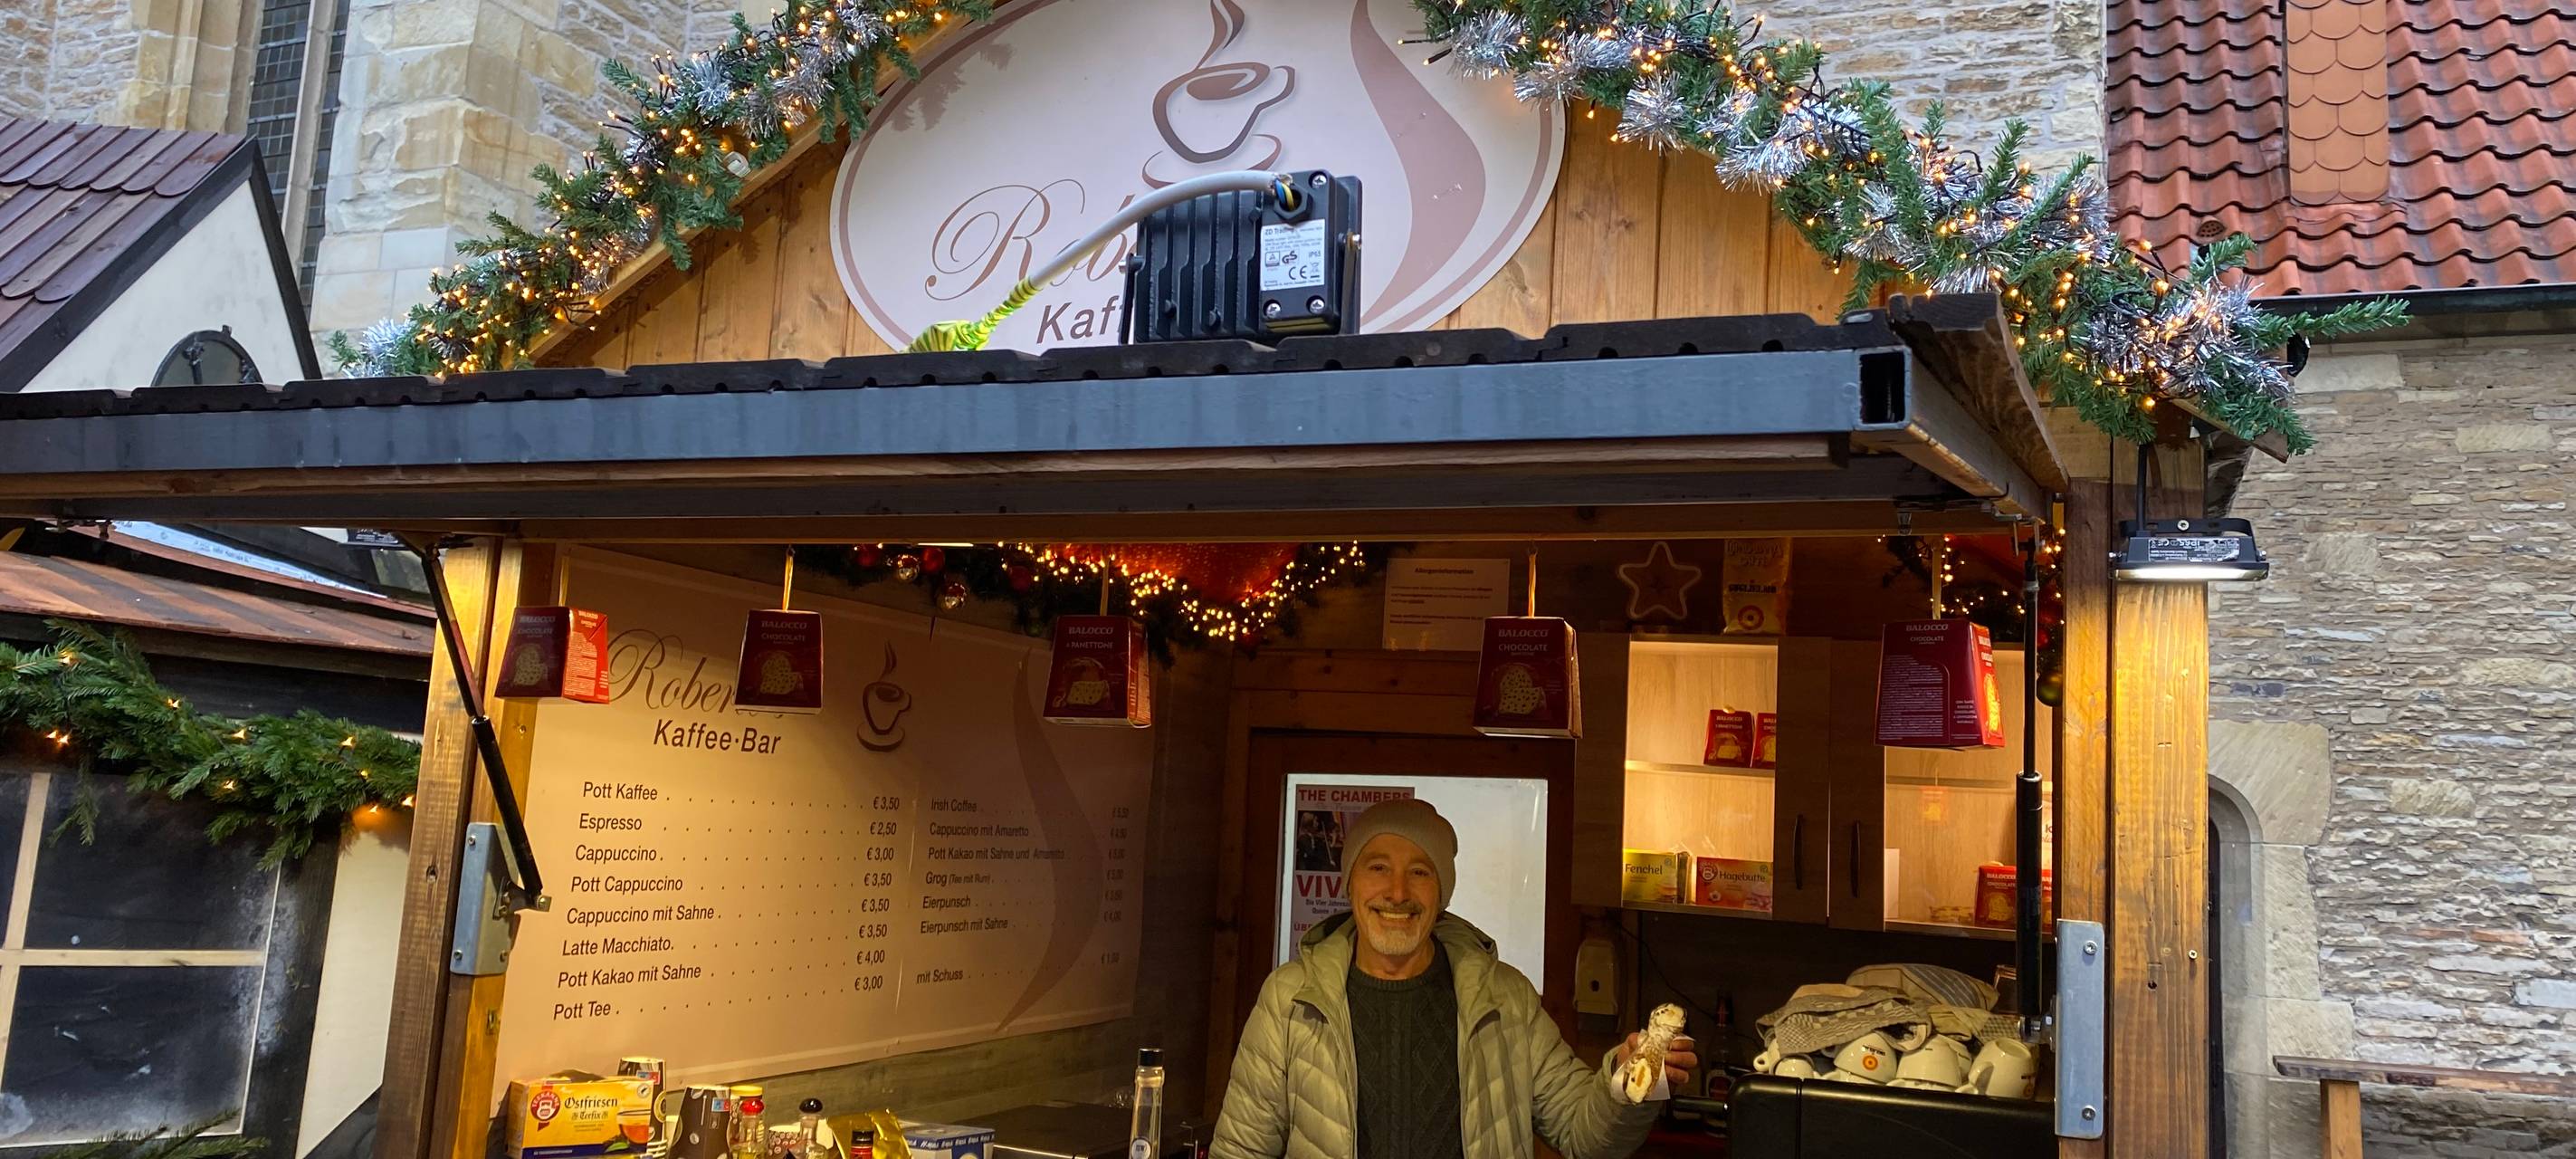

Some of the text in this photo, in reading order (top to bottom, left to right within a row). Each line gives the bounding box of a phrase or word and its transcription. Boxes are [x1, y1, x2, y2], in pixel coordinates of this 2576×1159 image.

[1036, 295, 1125, 344] Kaf
[760, 620, 807, 630] BALOCCO
[1068, 627, 1113, 635] BALOCCO
[1498, 628, 1550, 637] BALOCCO
[1906, 623, 1949, 632] BALOCCO
[1498, 644, 1548, 652] CHOCOLATE
[583, 781, 900, 810] Pott Kaffee € 3,50
[1298, 790, 1326, 801] THE
[930, 797, 949, 812] Irish
[950, 798, 977, 813] Coffee
[579, 813, 897, 835] Espresso € 2,50
[930, 822, 978, 838] Cappuccino
[980, 825, 994, 837] mit
[996, 824, 1028, 837] Amaretto
[575, 845, 894, 865] Cappuccino € 3,00
[928, 848, 946, 859] Pott
[948, 848, 974, 859] Kakao
[976, 848, 988, 859] mit
[990, 848, 1014, 859] Sahne
[1016, 848, 1029, 859] und
[1625, 863, 1663, 875] Fenchel
[1720, 871, 1766, 882] Hagebutte
[571, 873, 892, 895] Pott Cappuccino € 3,50
[926, 872, 947, 886] Grog
[1296, 875, 1342, 898] VIV
[922, 895, 971, 910] Eierpunsch
[567, 898, 890, 926] Cappuccino mit Sahne € 3,50
[921, 919, 969, 934] Eierpunsch
[970, 919, 983, 931] mit
[984, 917, 1008, 930] Sahne
[562, 924, 887, 956] Latte Macchiato € 3,50
[558, 950, 885, 988] Pott Kakao mit Sahne € 4,00
[917, 971, 931, 984] mit
[933, 969, 963, 982] Schuss
[553, 975, 883, 1020] Pott Tee € 3,00
[564, 1096, 618, 1110] Ostfriesen
